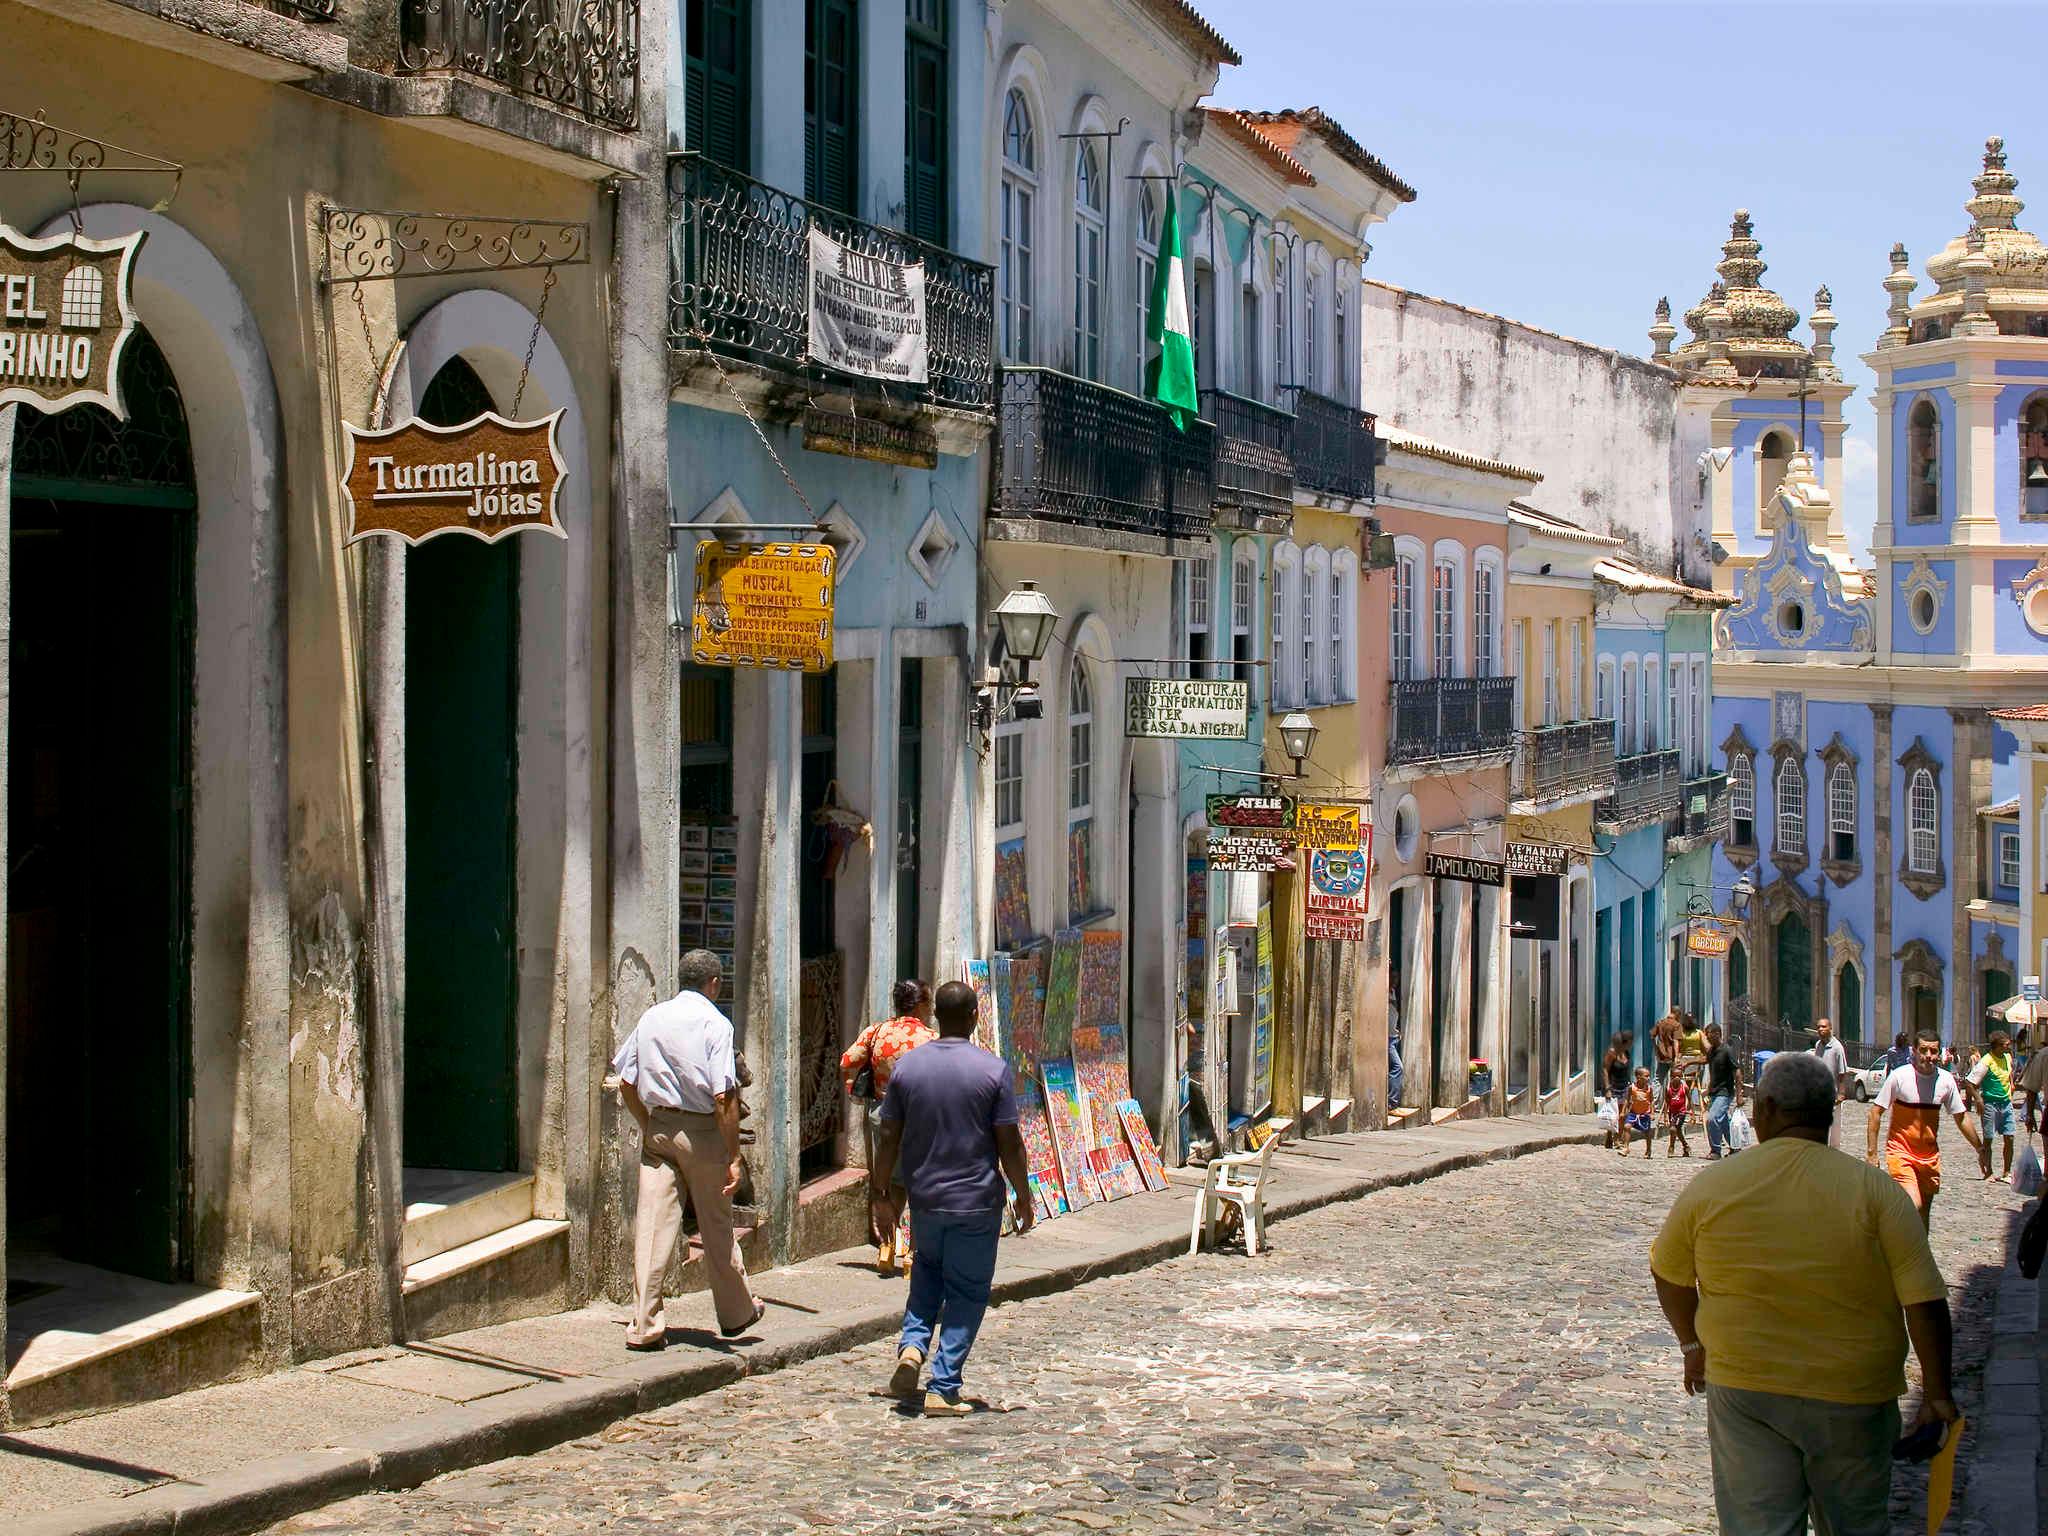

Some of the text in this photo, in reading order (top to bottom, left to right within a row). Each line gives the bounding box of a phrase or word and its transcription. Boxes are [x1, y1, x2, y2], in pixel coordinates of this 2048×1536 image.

[846, 252, 877, 286] AULA
[368, 452, 541, 491] Turmalina
[467, 487, 543, 517] Jóias
[742, 575, 793, 592] MUSICAL
[735, 594, 803, 607] INSTRUMENTOS
[744, 607, 789, 618] MUSICAIS
[731, 618, 760, 630] CURSO
[728, 630, 819, 647] EVENTOS CULTURAIS
[1129, 681, 1246, 697] NIGERIA CULTURAL
[1130, 695, 1242, 711] AND INFORMATION
[1130, 707, 1182, 720] CENTER
[1129, 720, 1138, 732] A
[1140, 721, 1177, 734] CASA
[1180, 722, 1198, 735] DA
[1223, 837, 1276, 847] HOSTEL
[1208, 845, 1283, 856] ALBERGUE
[1239, 854, 1258, 863] DA
[1506, 853, 1545, 864] LANCHES
[1211, 861, 1276, 871] AMIZADE
[1435, 856, 1499, 882] AMOLADOR
[1506, 860, 1552, 873] SORVETES
[1311, 894, 1363, 911] VIRTUAL
[1310, 916, 1360, 929] INTERNET
